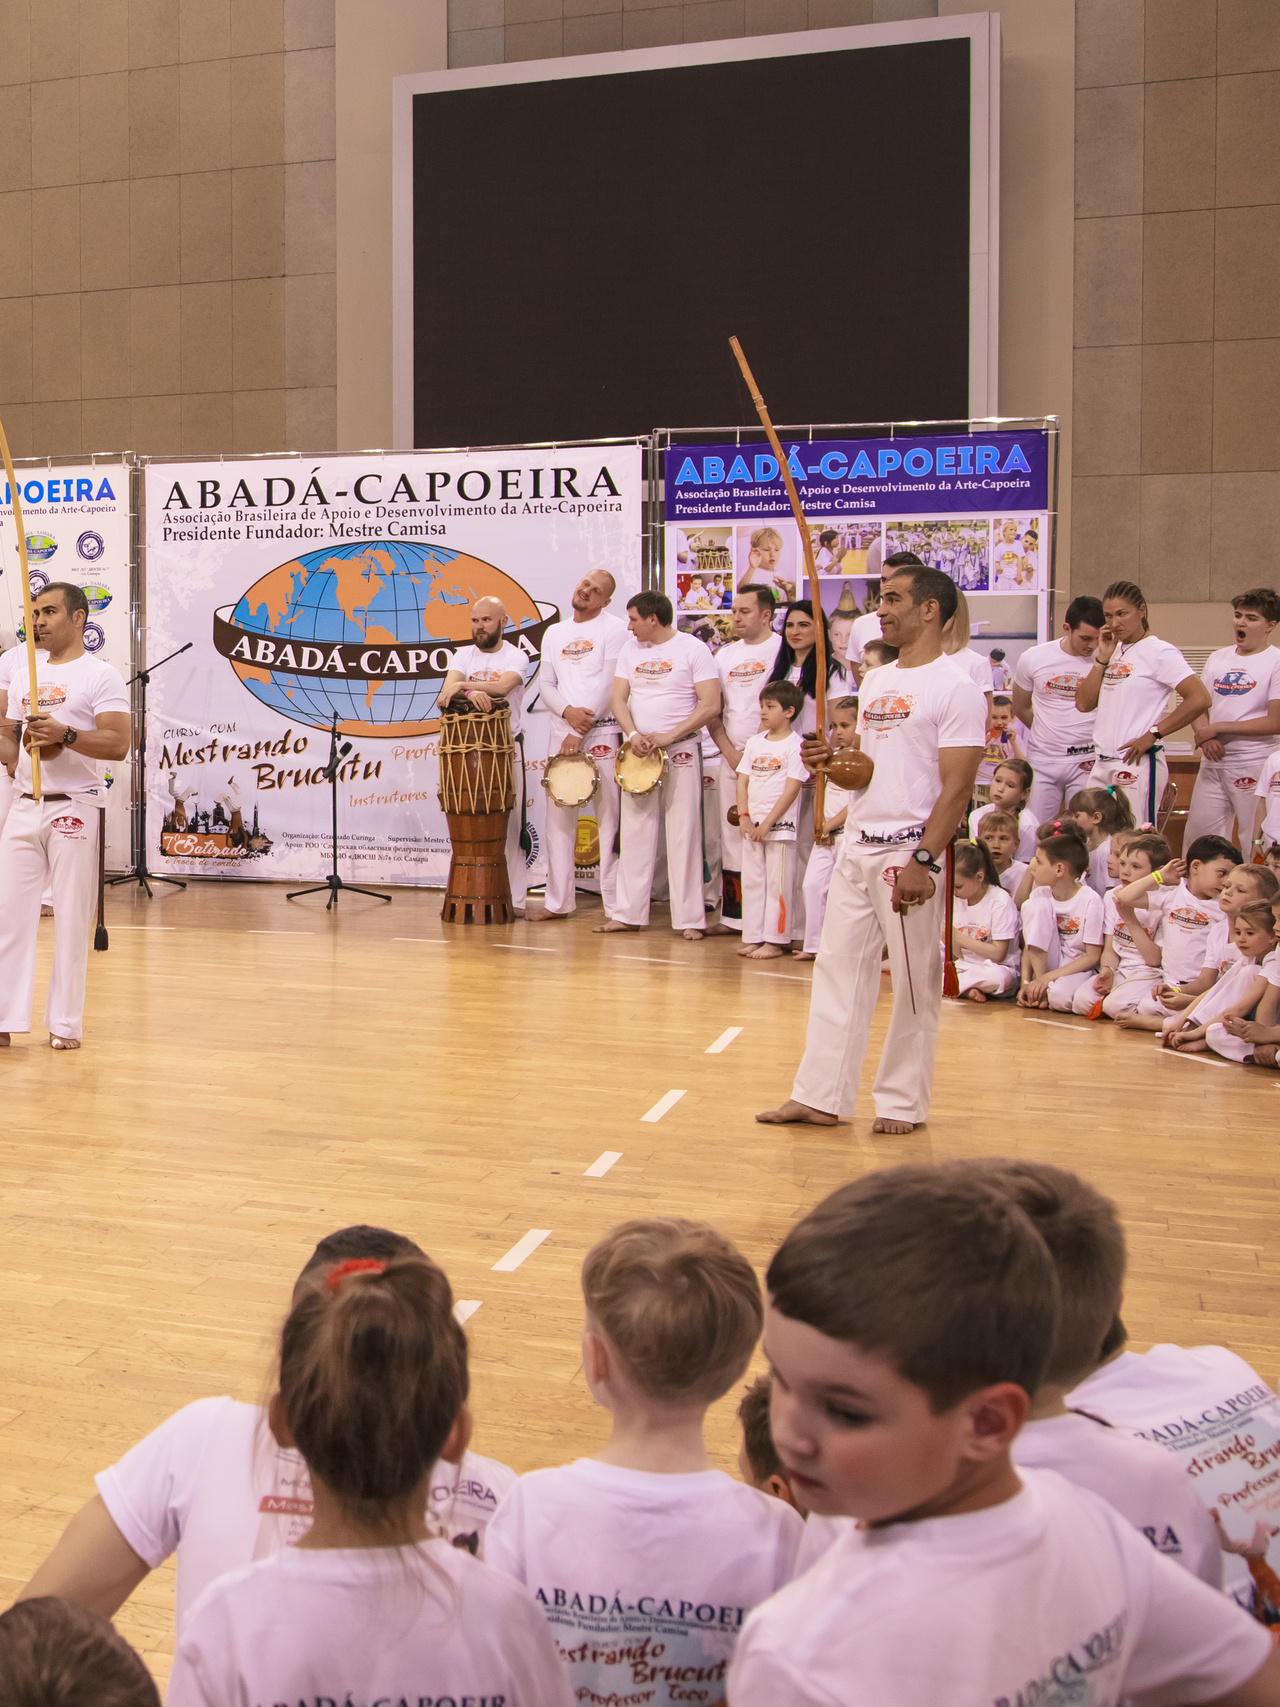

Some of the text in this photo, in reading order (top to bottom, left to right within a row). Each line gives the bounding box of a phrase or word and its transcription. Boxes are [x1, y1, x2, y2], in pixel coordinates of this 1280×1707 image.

[674, 444, 1032, 485] ABADÁ-CAPOEIRA
[162, 466, 622, 510] ABADÁ-CAPOEIRA
[675, 490, 730, 501] Associação
[732, 487, 781, 498] Brasileira
[799, 485, 831, 498] Apoio
[842, 482, 936, 494] Desenvolvimento
[938, 480, 952, 490] da
[954, 478, 1031, 491] Arte-Capoeira
[48, 505, 59, 514] da
[60, 503, 116, 515] Arte-Capoeira
[163, 500, 622, 526] Associação Brasileira de Apoio e Desenvolvimento da Arte-Capoeira
[675, 504, 732, 514] Presidente
[734, 502, 791, 513] Fundador:
[834, 498, 876, 509] Camisa
[162, 520, 447, 541] Presidente Fundador: Mestre Camisa
[229, 634, 541, 675] ABADÁ-CAPOA
[163, 722, 237, 739] CURSO COM
[159, 729, 309, 770] Mestrando
[391, 742, 440, 761] Profe
[349, 790, 428, 807] Instrutores
[173, 835, 249, 858] Batizado
[352, 834, 376, 842] Curinga
[424, 836, 446, 844] Mestre
[1133, 1384, 1271, 1442] ADÁ-CAPOEIR
[1186, 1434, 1256, 1478] strando
[536, 1587, 746, 1628] ABADÁ-CAPOEI
[629, 1658, 729, 1685] Brucut
